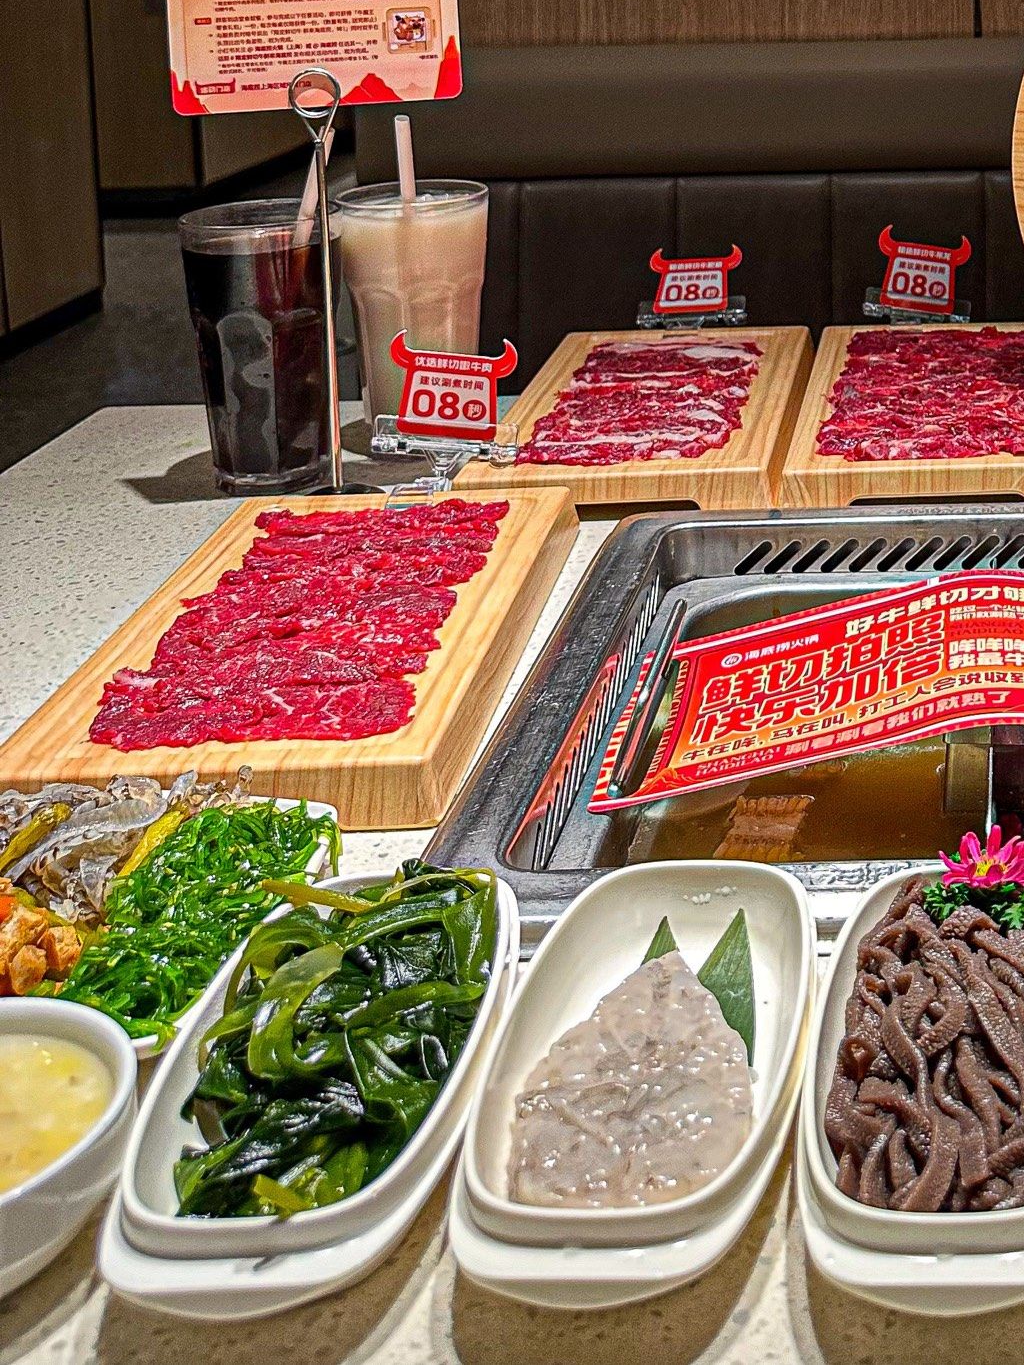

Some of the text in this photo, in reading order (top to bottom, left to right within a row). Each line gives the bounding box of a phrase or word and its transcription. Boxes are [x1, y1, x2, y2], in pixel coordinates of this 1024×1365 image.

[420, 376, 485, 391] 建议涮煮时间
[744, 634, 820, 660] 海底捞火锅
[699, 610, 945, 715] 鲜切拍照
[690, 643, 943, 745] 快乐加倍
[784, 691, 1011, 756] 涮着涮着我们就熟了
[696, 754, 775, 777] HAIDILAO
[697, 747, 781, 772] SHANGHAI
